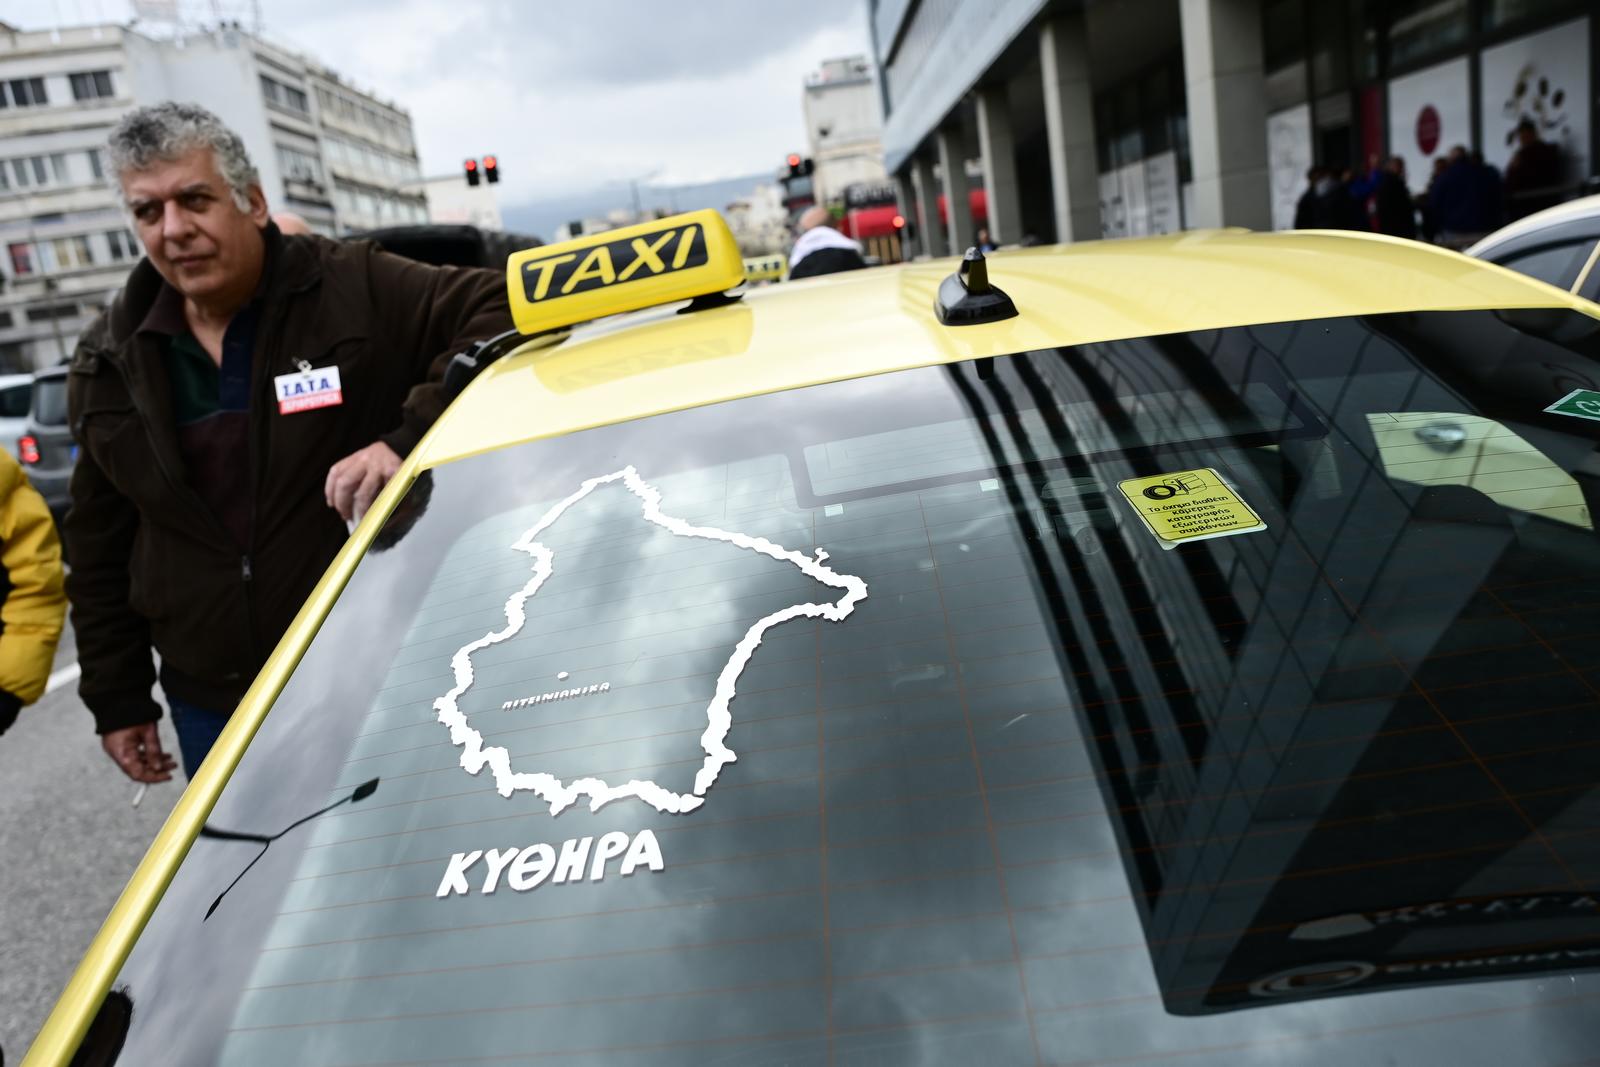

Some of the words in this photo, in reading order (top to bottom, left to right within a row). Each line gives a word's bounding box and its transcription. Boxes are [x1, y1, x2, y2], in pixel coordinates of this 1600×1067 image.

[527, 225, 698, 300] TAXI
[1167, 508, 1230, 523] καταγραφής
[1172, 504, 1215, 515] κάμερες
[1172, 514, 1235, 529] εξωτερικών
[436, 829, 664, 897] ΚΥΘΗΡΑ
